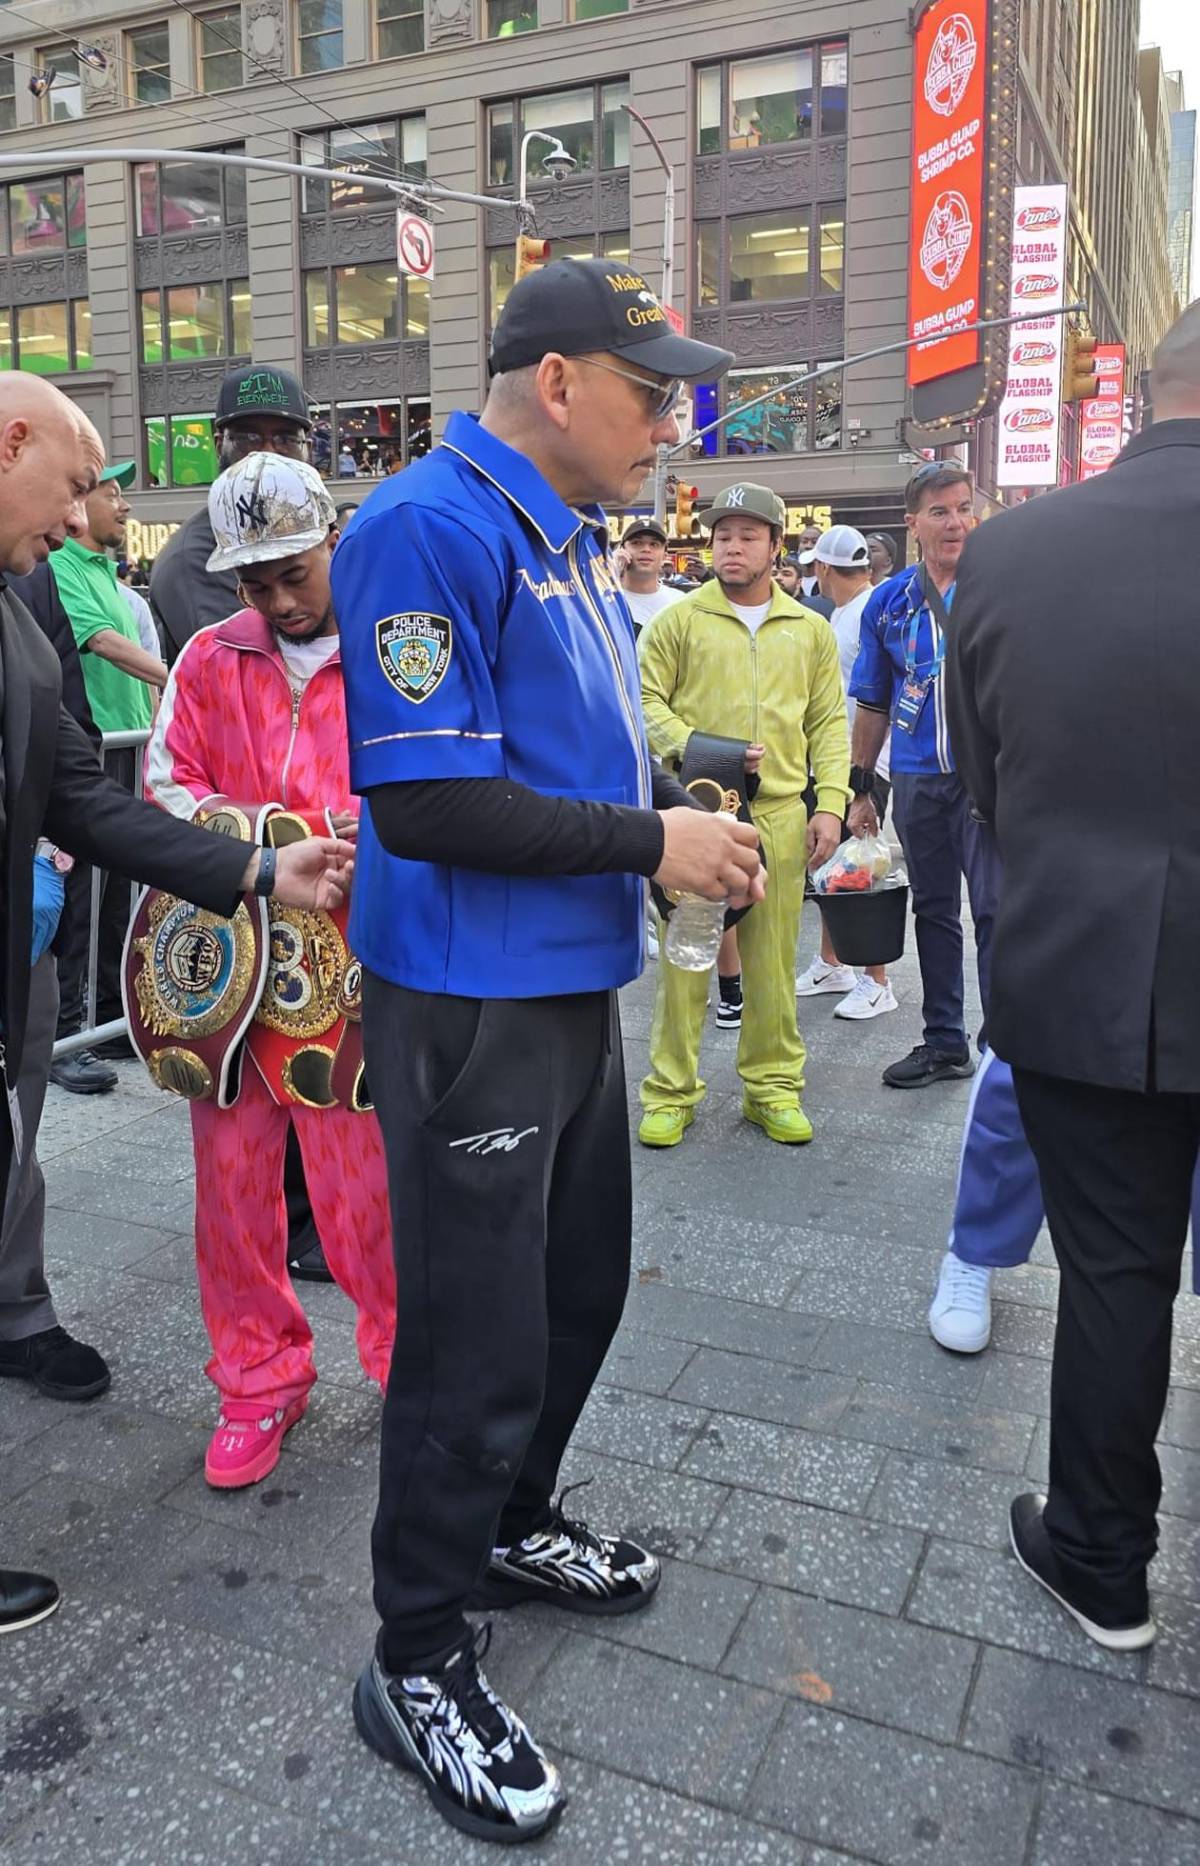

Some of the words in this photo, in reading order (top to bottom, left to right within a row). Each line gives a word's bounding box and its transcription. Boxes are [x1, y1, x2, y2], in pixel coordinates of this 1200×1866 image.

[918, 138, 949, 169] BUBBA
[950, 119, 980, 148] GUMP
[921, 151, 956, 183] SHRIMP
[957, 140, 975, 160] CO.
[1014, 254, 1057, 263] LAGSHIP
[605, 273, 646, 292] Make
[913, 312, 945, 337] BUBBA
[945, 298, 975, 322] GUMP
[1014, 321, 1056, 330] LAGSHIP
[1008, 378, 1053, 389] GLOBAL
[1007, 388, 1053, 398] FLAGSHIP
[1005, 443, 1051, 454] GLOBAL
[1005, 454, 1051, 463] FLAGSHIP
[726, 487, 746, 507] NY
[393, 616, 431, 629] POLICE
[381, 626, 446, 644] DEPARTMENT
[383, 655, 398, 677] CITY
[396, 677, 409, 690] OF
[421, 674, 438, 693] NEW
[434, 648, 448, 672] YORK
[197, 942, 214, 981] WBO
[156, 964, 179, 1009] WORLD
